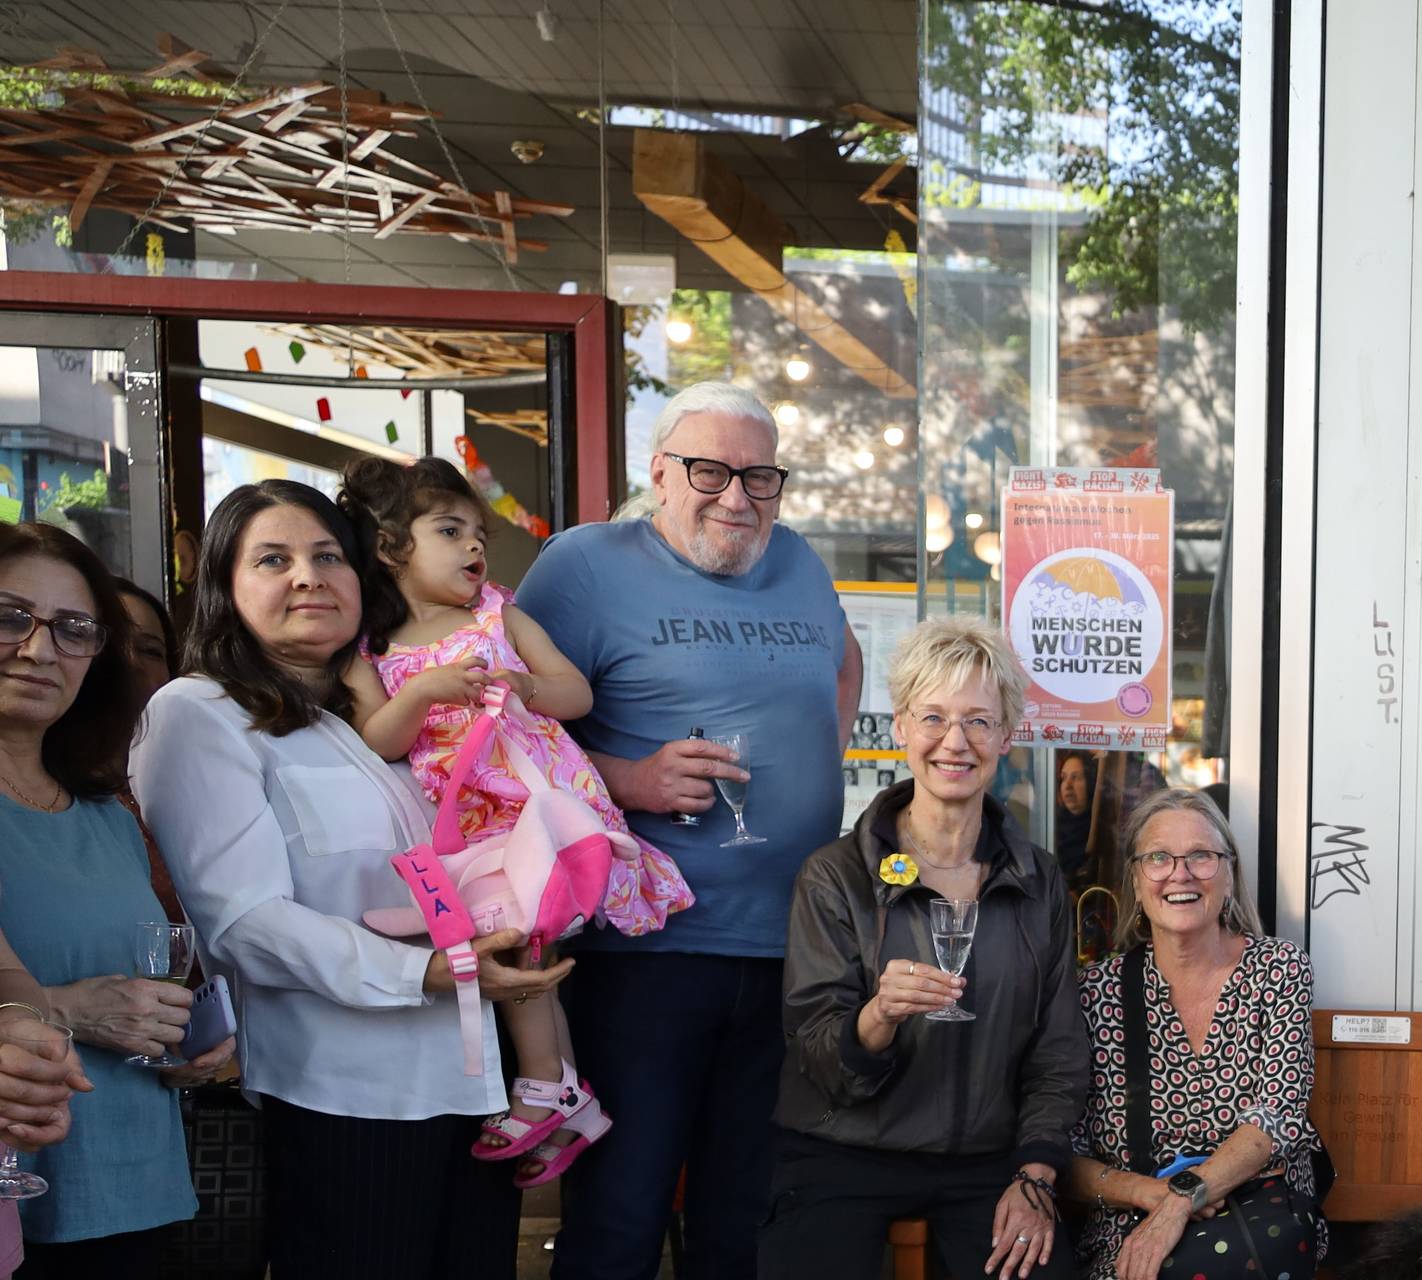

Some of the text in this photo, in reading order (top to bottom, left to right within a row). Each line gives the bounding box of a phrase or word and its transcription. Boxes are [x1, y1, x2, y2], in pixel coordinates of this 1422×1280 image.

[1091, 471, 1116, 481] STOP
[652, 619, 735, 646] JEAN
[1032, 617, 1142, 633] MENSCHEN
[1032, 632, 1142, 657] WÜRDE
[1032, 656, 1142, 675] SCHÜTZEN
[1079, 725, 1102, 733] STOP
[1072, 734, 1109, 744] RACISM!
[1358, 1092, 1392, 1106] Platz
[1396, 1093, 1420, 1106] für
